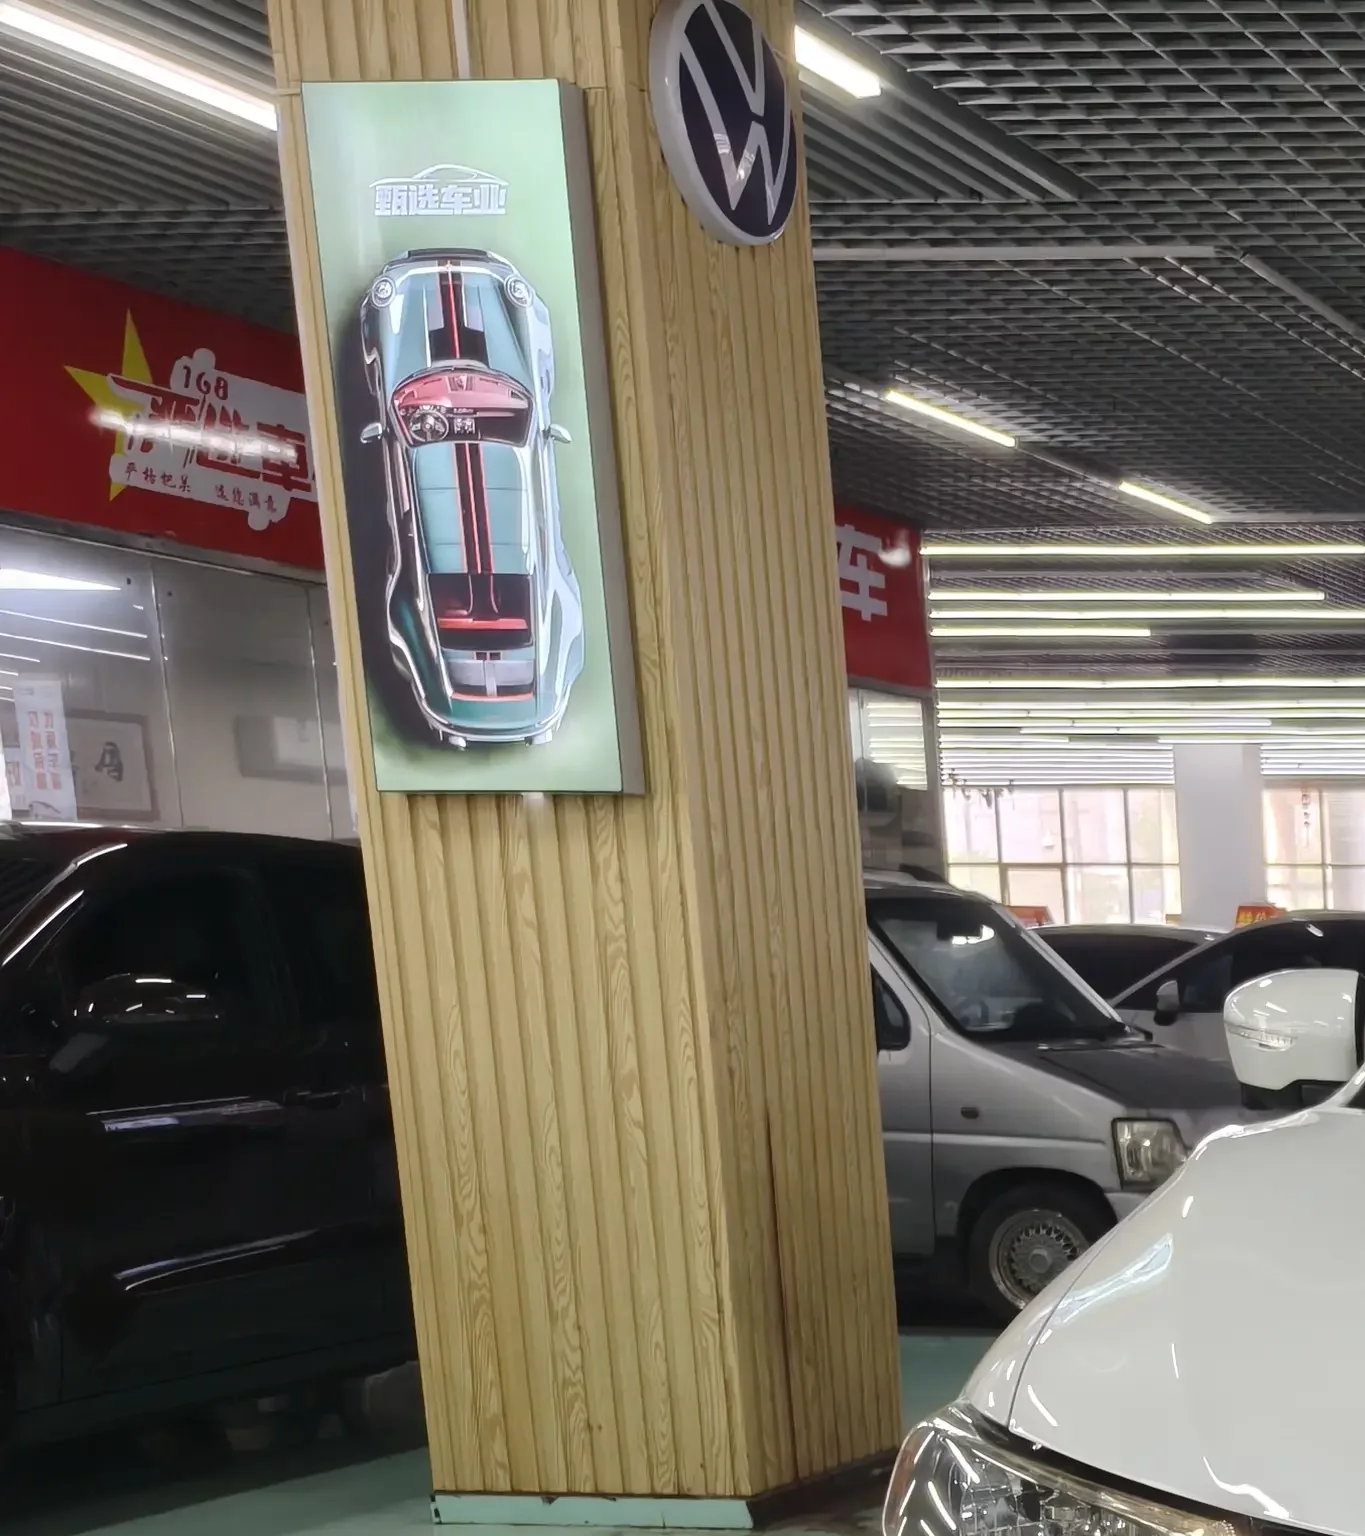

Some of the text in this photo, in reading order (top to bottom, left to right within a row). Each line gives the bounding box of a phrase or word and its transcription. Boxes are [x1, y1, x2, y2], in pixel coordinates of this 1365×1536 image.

[374, 184, 507, 216] 甄选车业
[182, 364, 230, 401] 168
